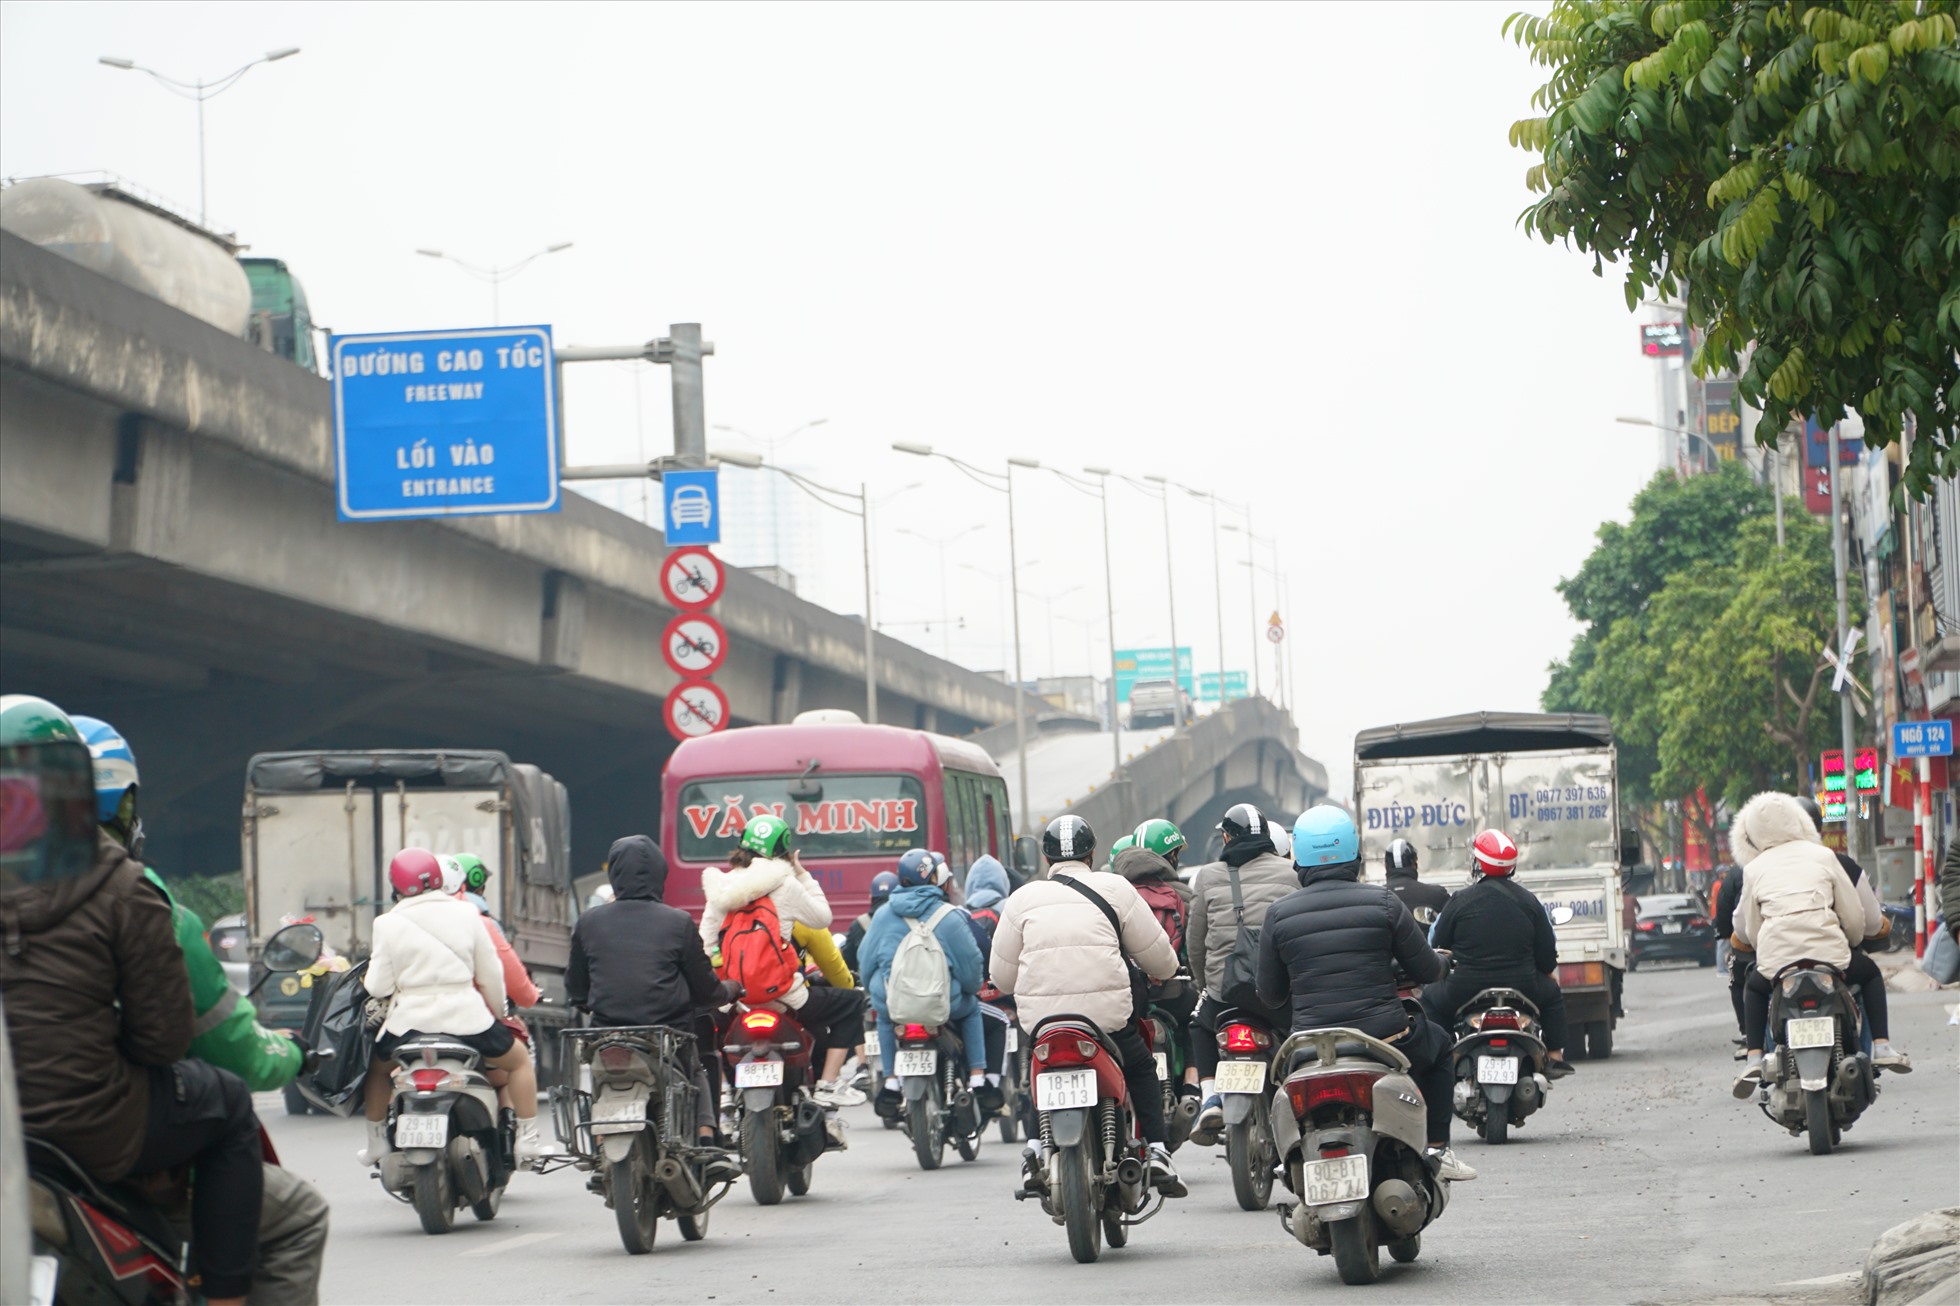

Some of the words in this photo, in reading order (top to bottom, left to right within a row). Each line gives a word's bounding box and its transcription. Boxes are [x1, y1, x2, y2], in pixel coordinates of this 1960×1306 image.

[343, 347, 425, 377] ĐƯỜNG
[437, 349, 484, 372] CAO
[497, 339, 543, 369] TỐC
[405, 382, 484, 403] FREEWAY
[396, 438, 435, 469] LỐI
[450, 438, 494, 466] VÀO
[402, 476, 495, 497] ENTRANCE
[1926, 725, 1945, 742] 124
[1536, 788, 1562, 803] 0977
[1565, 787, 1584, 802] 397
[1587, 785, 1607, 801] 636
[796, 799, 918, 834] MINH
[1367, 801, 1416, 833] ĐIỆP
[1421, 797, 1466, 826] ĐỨC
[1537, 806, 1563, 822] 0967
[1566, 806, 1585, 821] 381
[1588, 804, 1608, 820] 262
[1163, 831, 1180, 845] Grab
[1224, 1064, 1258, 1077] 36-B7
[1484, 1058, 1512, 1071] 29-P1
[1047, 1073, 1087, 1091] 18-M1
[1480, 1070, 1515, 1082] 352.93
[1046, 1089, 1089, 1107] 4013
[404, 1117, 440, 1131] 29-H1
[399, 1131, 443, 1146] 010.39
[1313, 1159, 1356, 1182] 90-B1
